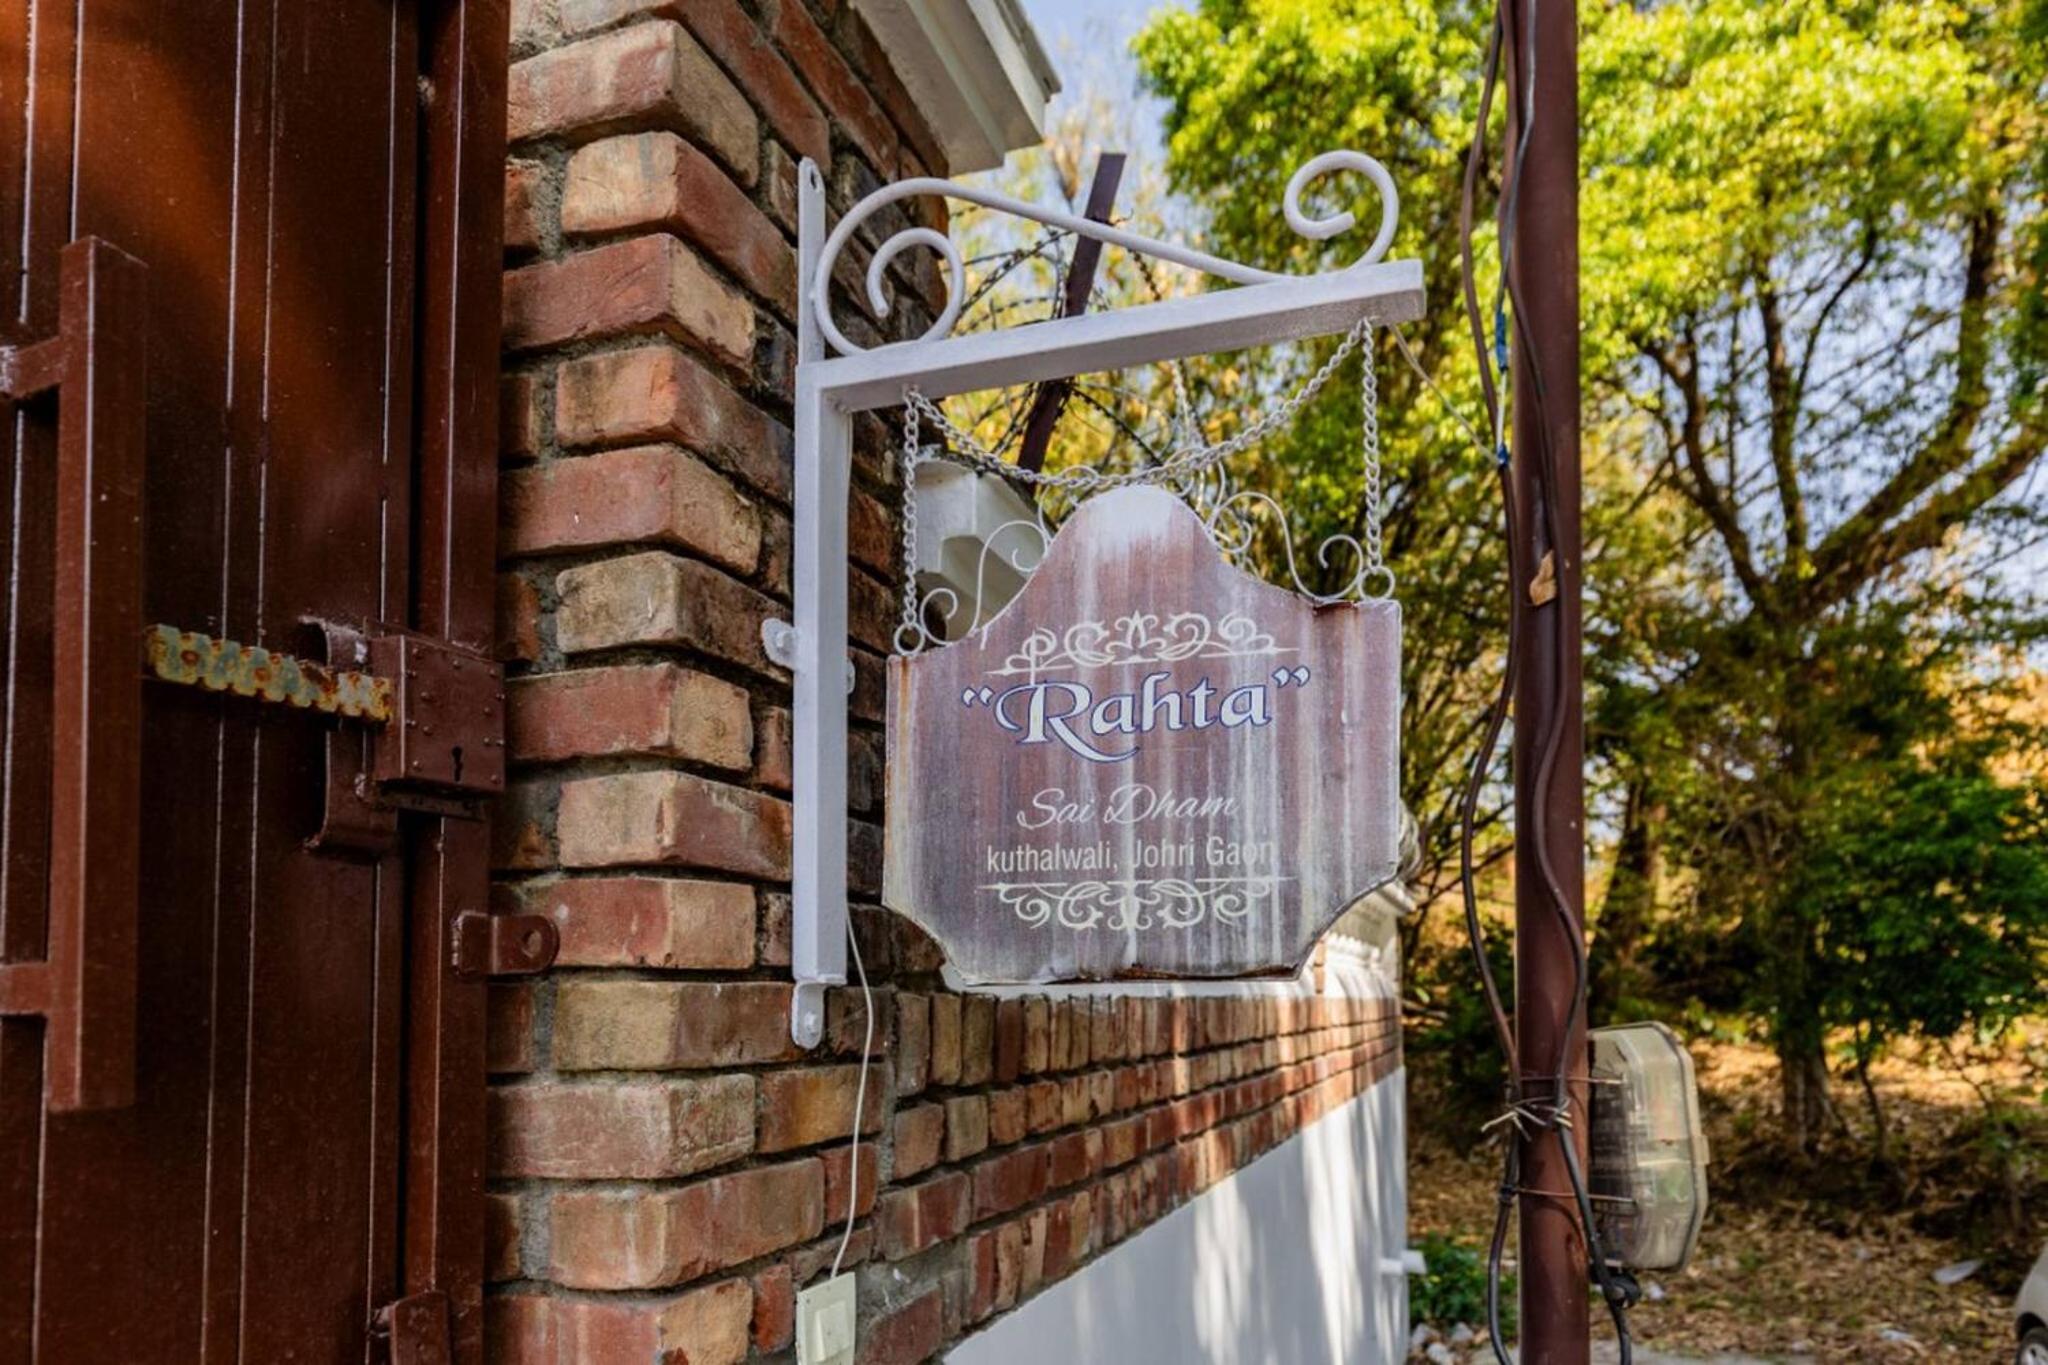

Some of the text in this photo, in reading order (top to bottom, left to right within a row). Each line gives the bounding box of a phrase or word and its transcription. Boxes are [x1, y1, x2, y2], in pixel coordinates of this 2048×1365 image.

[1016, 783, 1240, 830] Sai Dham
[987, 840, 1118, 873] kuthalwali,
[1133, 837, 1195, 868] Johri
